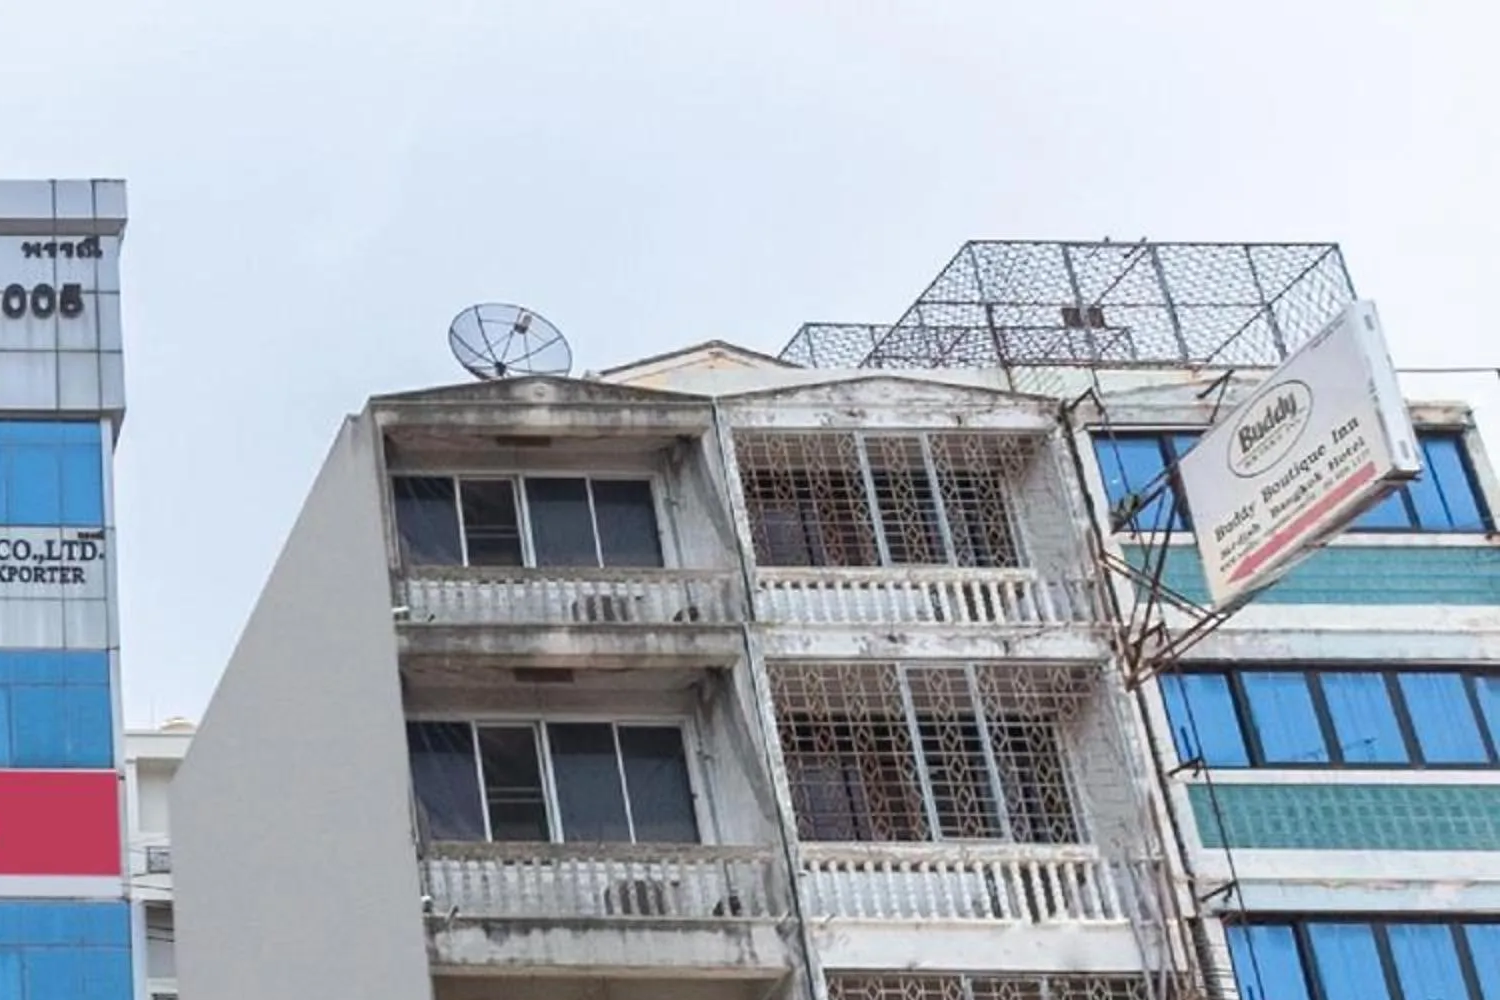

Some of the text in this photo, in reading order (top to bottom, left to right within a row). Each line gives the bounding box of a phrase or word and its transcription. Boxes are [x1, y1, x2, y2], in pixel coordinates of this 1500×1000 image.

[1238, 393, 1299, 454] Buddy
[1214, 501, 1256, 543] Buddy
[1261, 443, 1327, 503] Boutique
[1331, 416, 1360, 445] Inn
